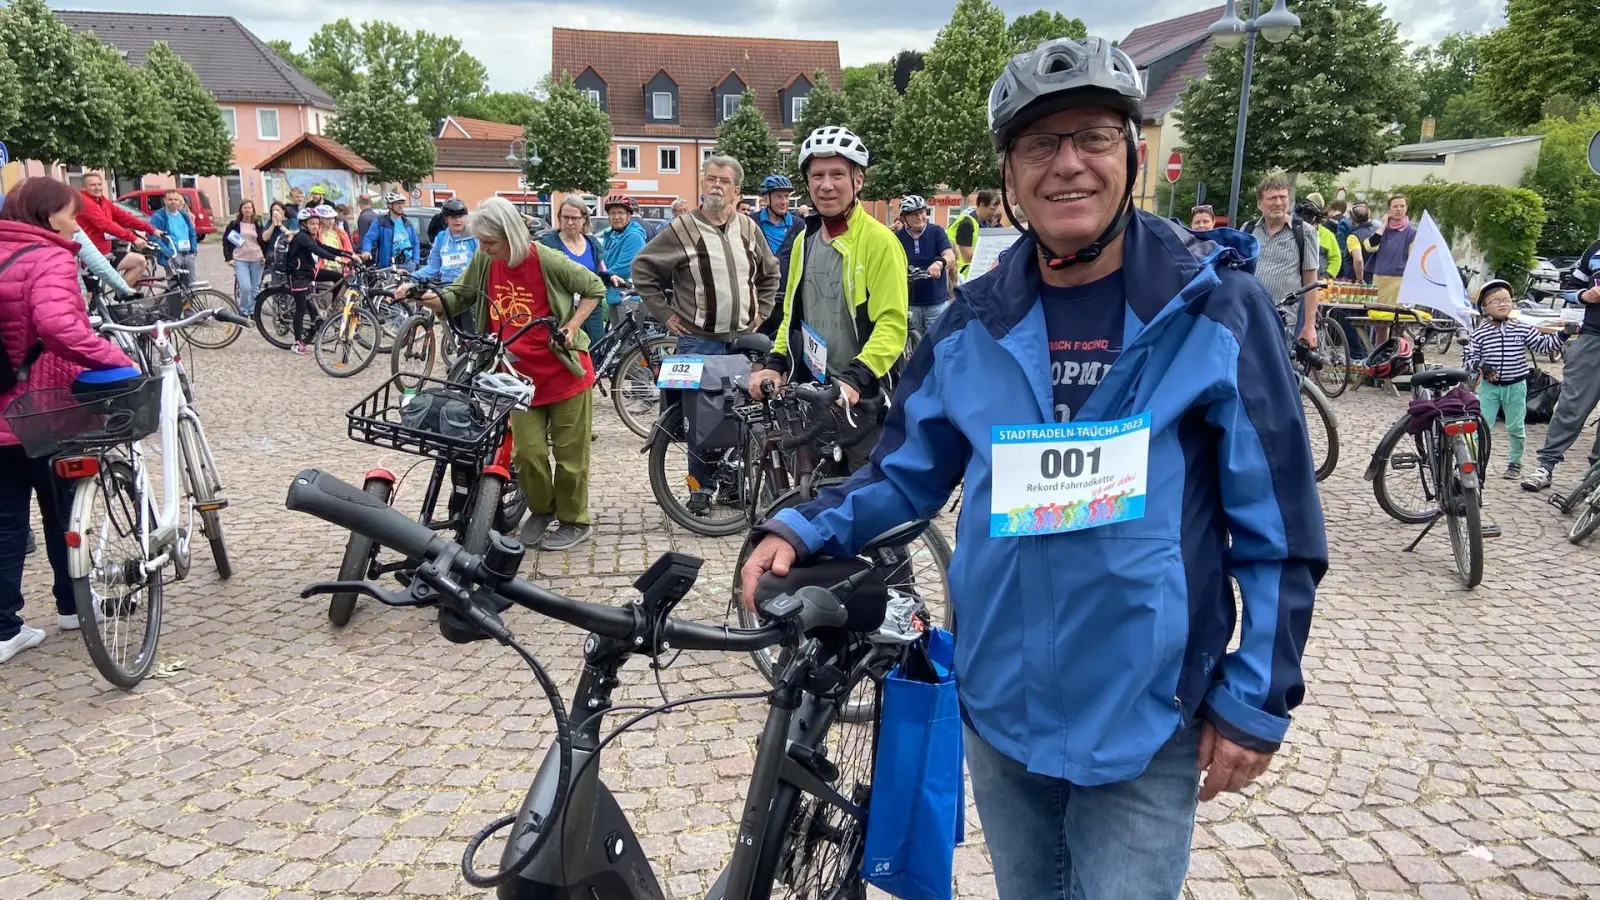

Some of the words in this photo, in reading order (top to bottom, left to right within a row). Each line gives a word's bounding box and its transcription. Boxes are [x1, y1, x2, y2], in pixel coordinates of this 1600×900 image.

[672, 364, 690, 373] 032
[999, 426, 1075, 440] STADTRADELN
[1076, 424, 1119, 437] TAUCHA
[1121, 419, 1143, 432] 2023
[1040, 447, 1101, 479] 001
[1026, 481, 1058, 492] Rekord
[1060, 474, 1115, 490] Fahrradkette
